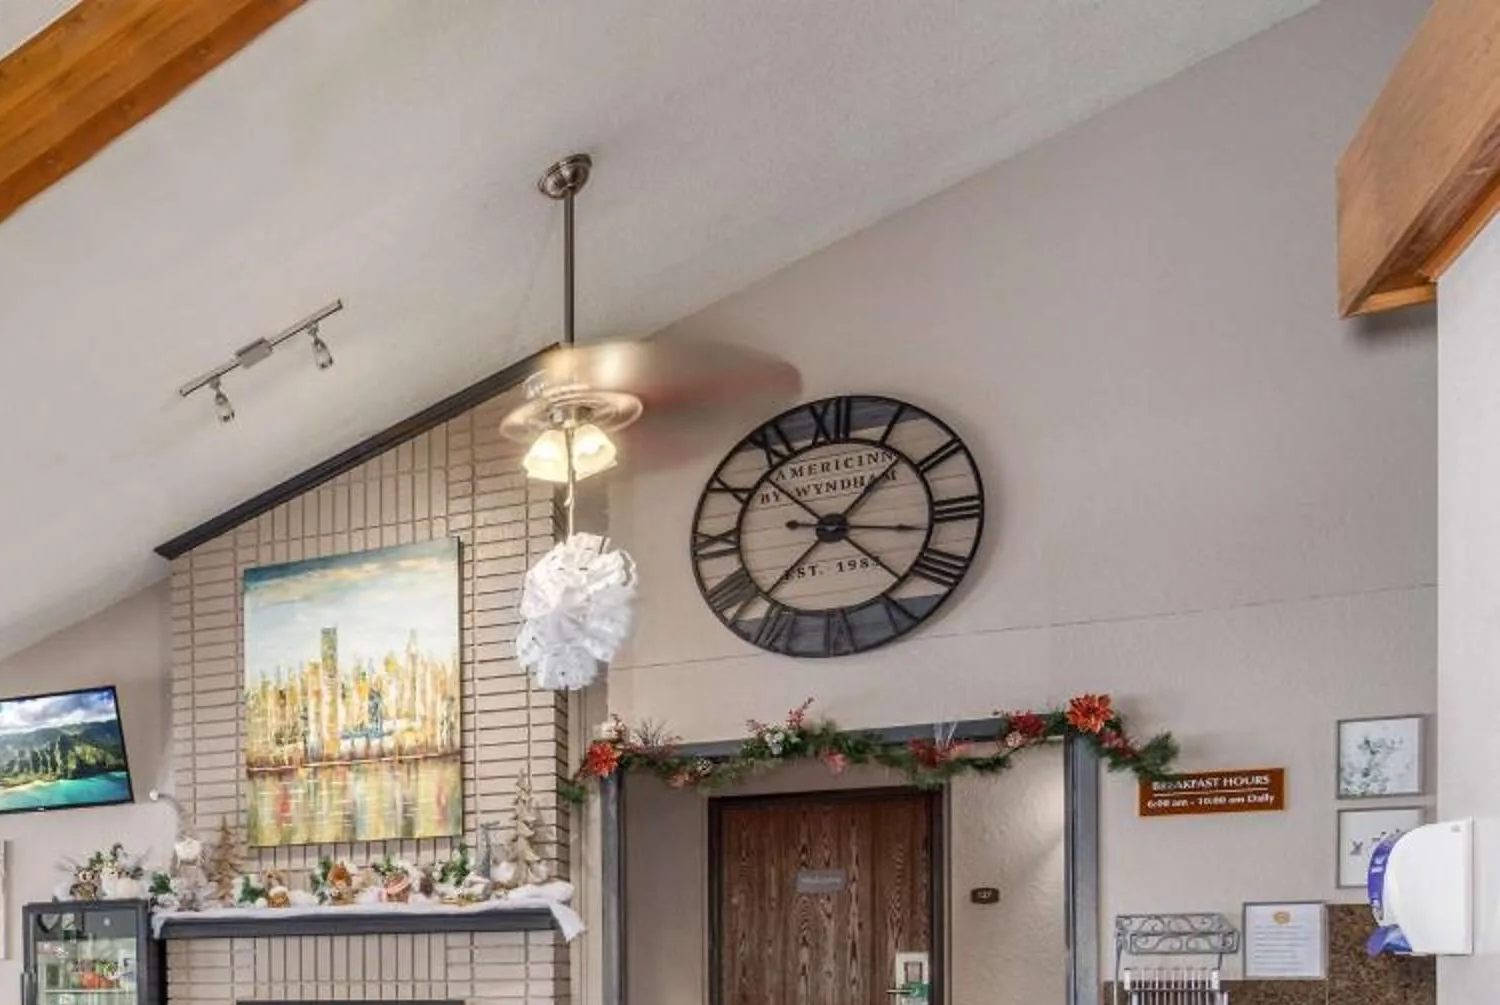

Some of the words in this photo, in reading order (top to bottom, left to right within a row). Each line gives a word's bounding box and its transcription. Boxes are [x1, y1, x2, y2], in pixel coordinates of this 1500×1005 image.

[775, 450, 898, 481] AMERICINN
[760, 491, 780, 504] BY
[795, 469, 897, 497] WYNDHAM
[1223, 774, 1269, 787] HOURS
